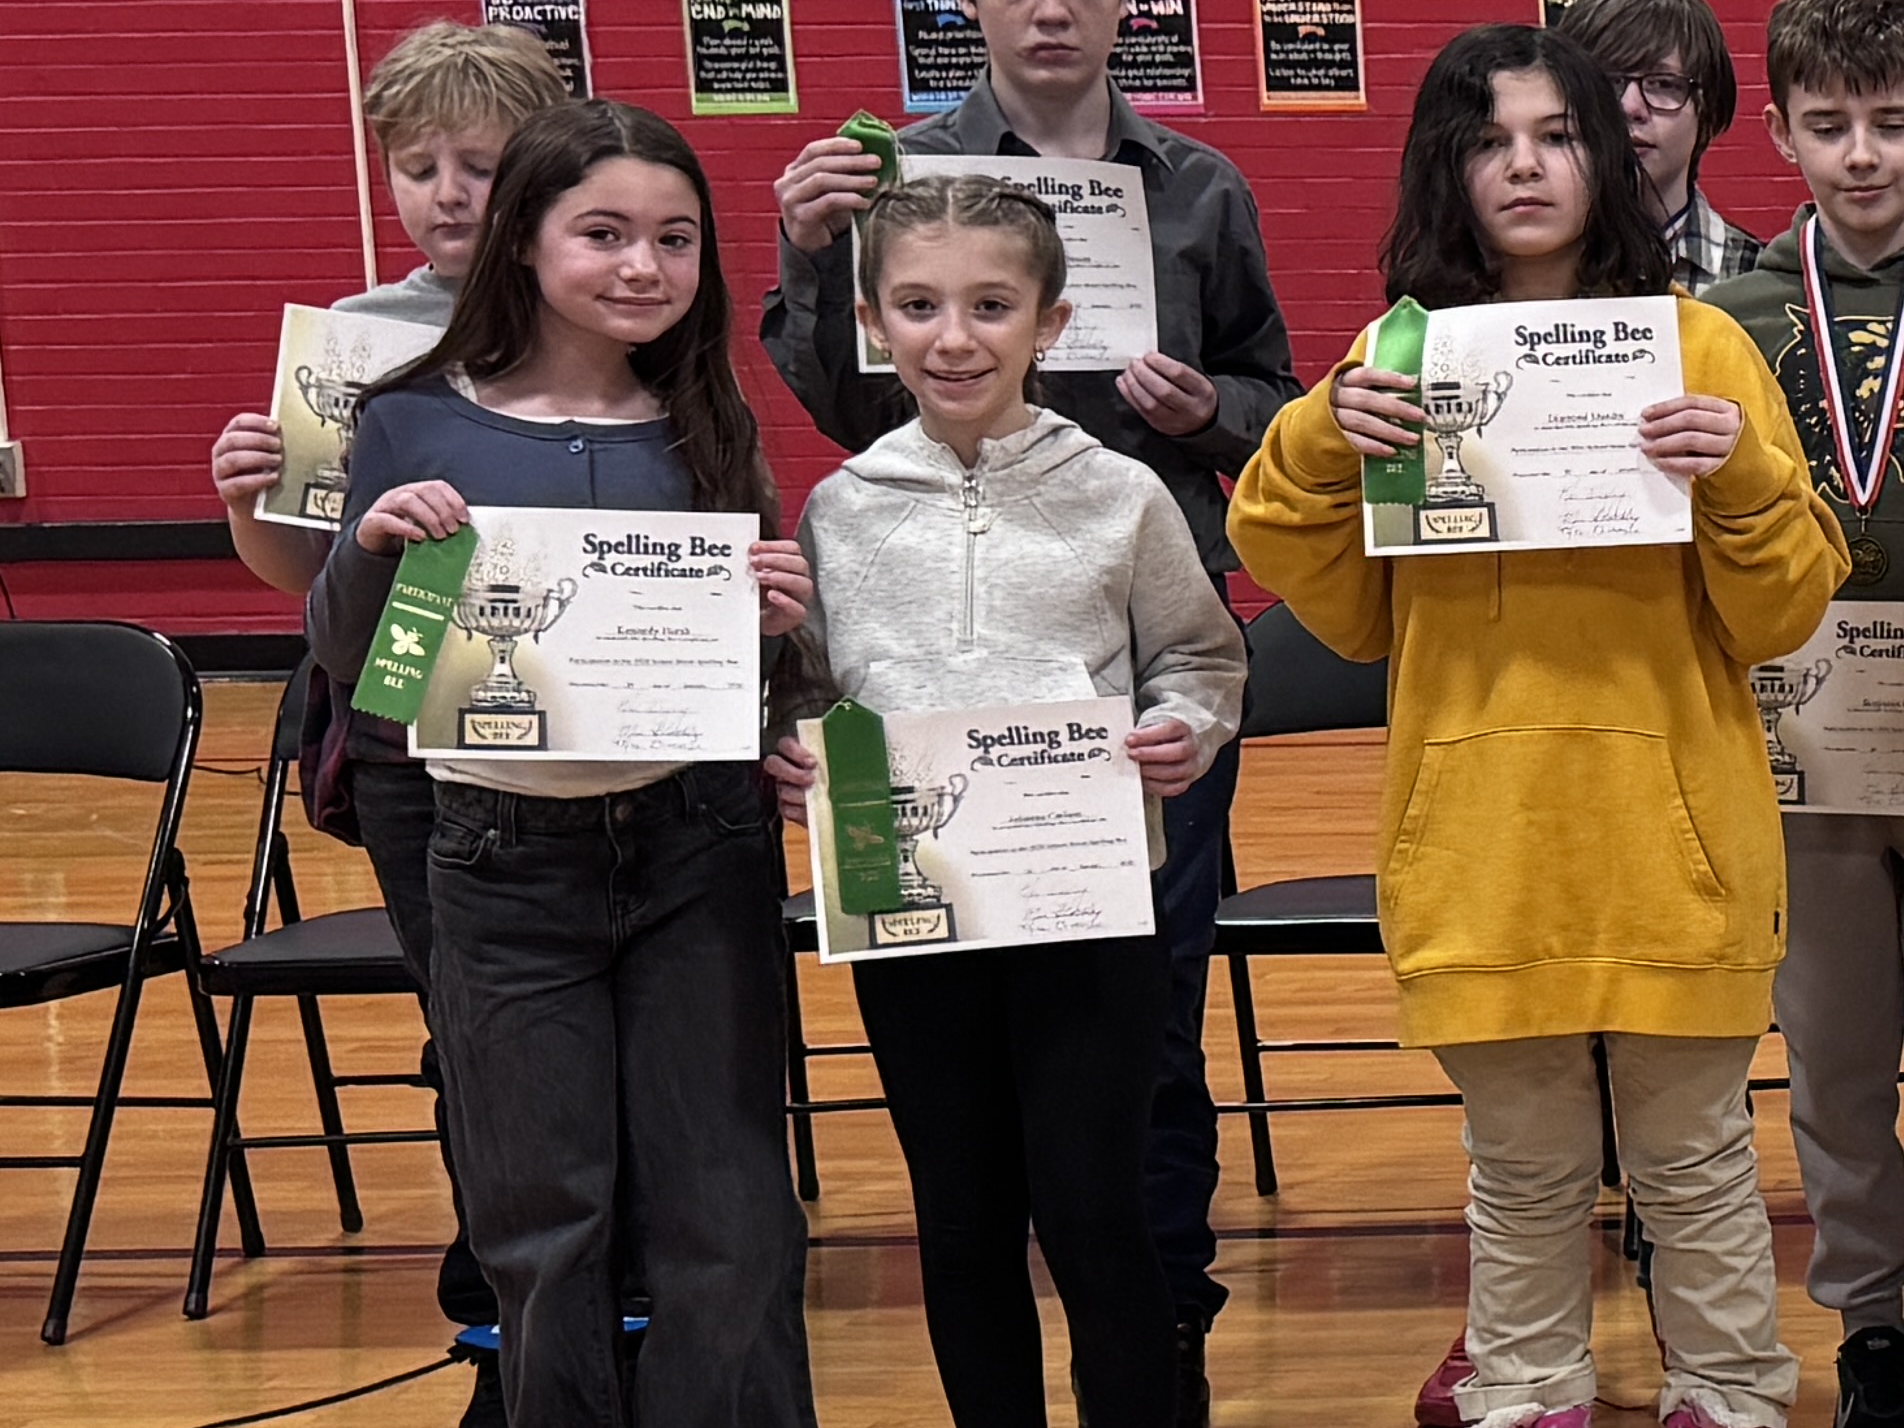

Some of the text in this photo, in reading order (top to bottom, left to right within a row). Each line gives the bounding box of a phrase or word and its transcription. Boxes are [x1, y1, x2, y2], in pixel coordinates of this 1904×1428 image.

[1089, 180, 1123, 199] Bee
[1053, 201, 1104, 216] tificate
[1514, 321, 1653, 350] Spelling Bee
[1542, 351, 1630, 367] Certificate
[582, 533, 732, 562] Spelling Bee
[609, 561, 704, 579] Certificate
[966, 723, 1108, 754] Spelling Bee
[997, 749, 1085, 769] Certificate
